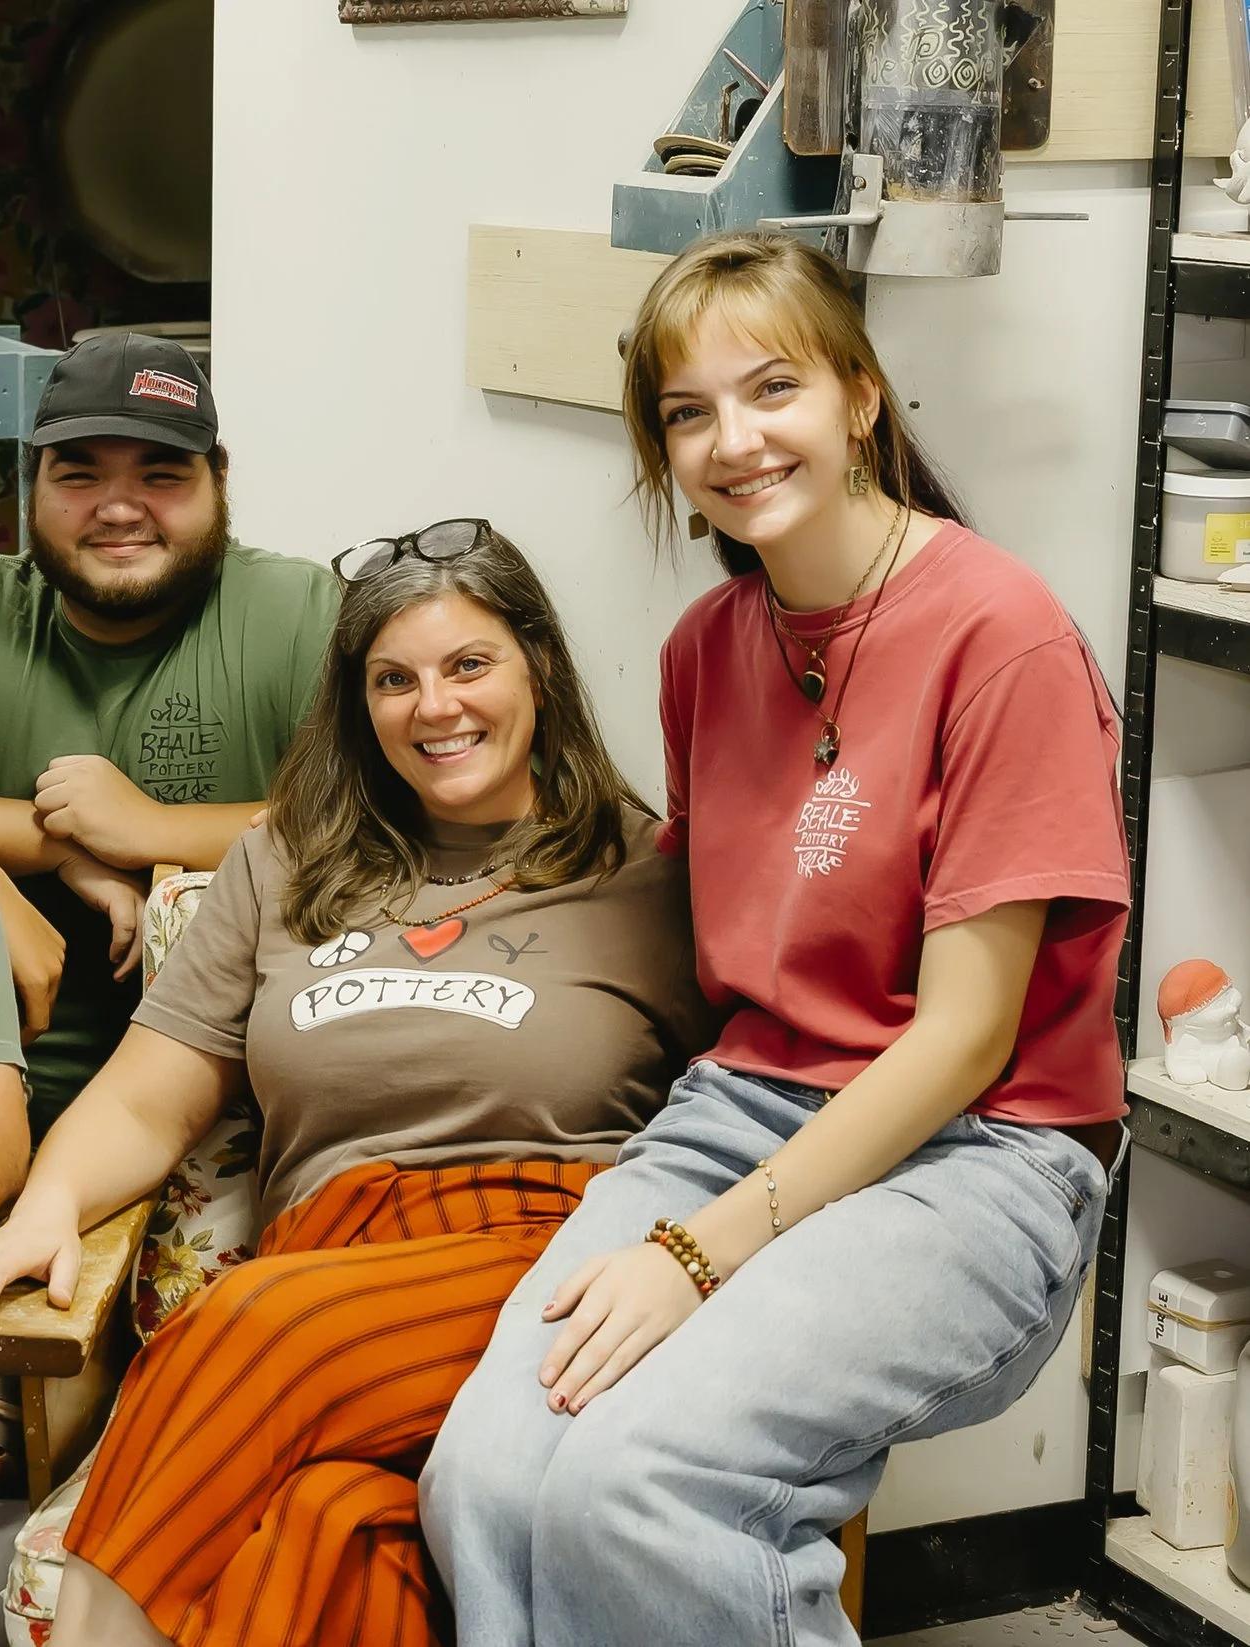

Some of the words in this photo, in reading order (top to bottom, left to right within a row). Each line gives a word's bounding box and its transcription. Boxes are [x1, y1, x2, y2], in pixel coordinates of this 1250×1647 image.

[138, 732, 222, 764] BEALE
[149, 760, 216, 776] POTTERY
[795, 802, 861, 833] BEALE
[799, 832, 849, 849] POTTERY
[305, 976, 524, 1018] POTTERY
[1155, 1292, 1169, 1339] TURLE
